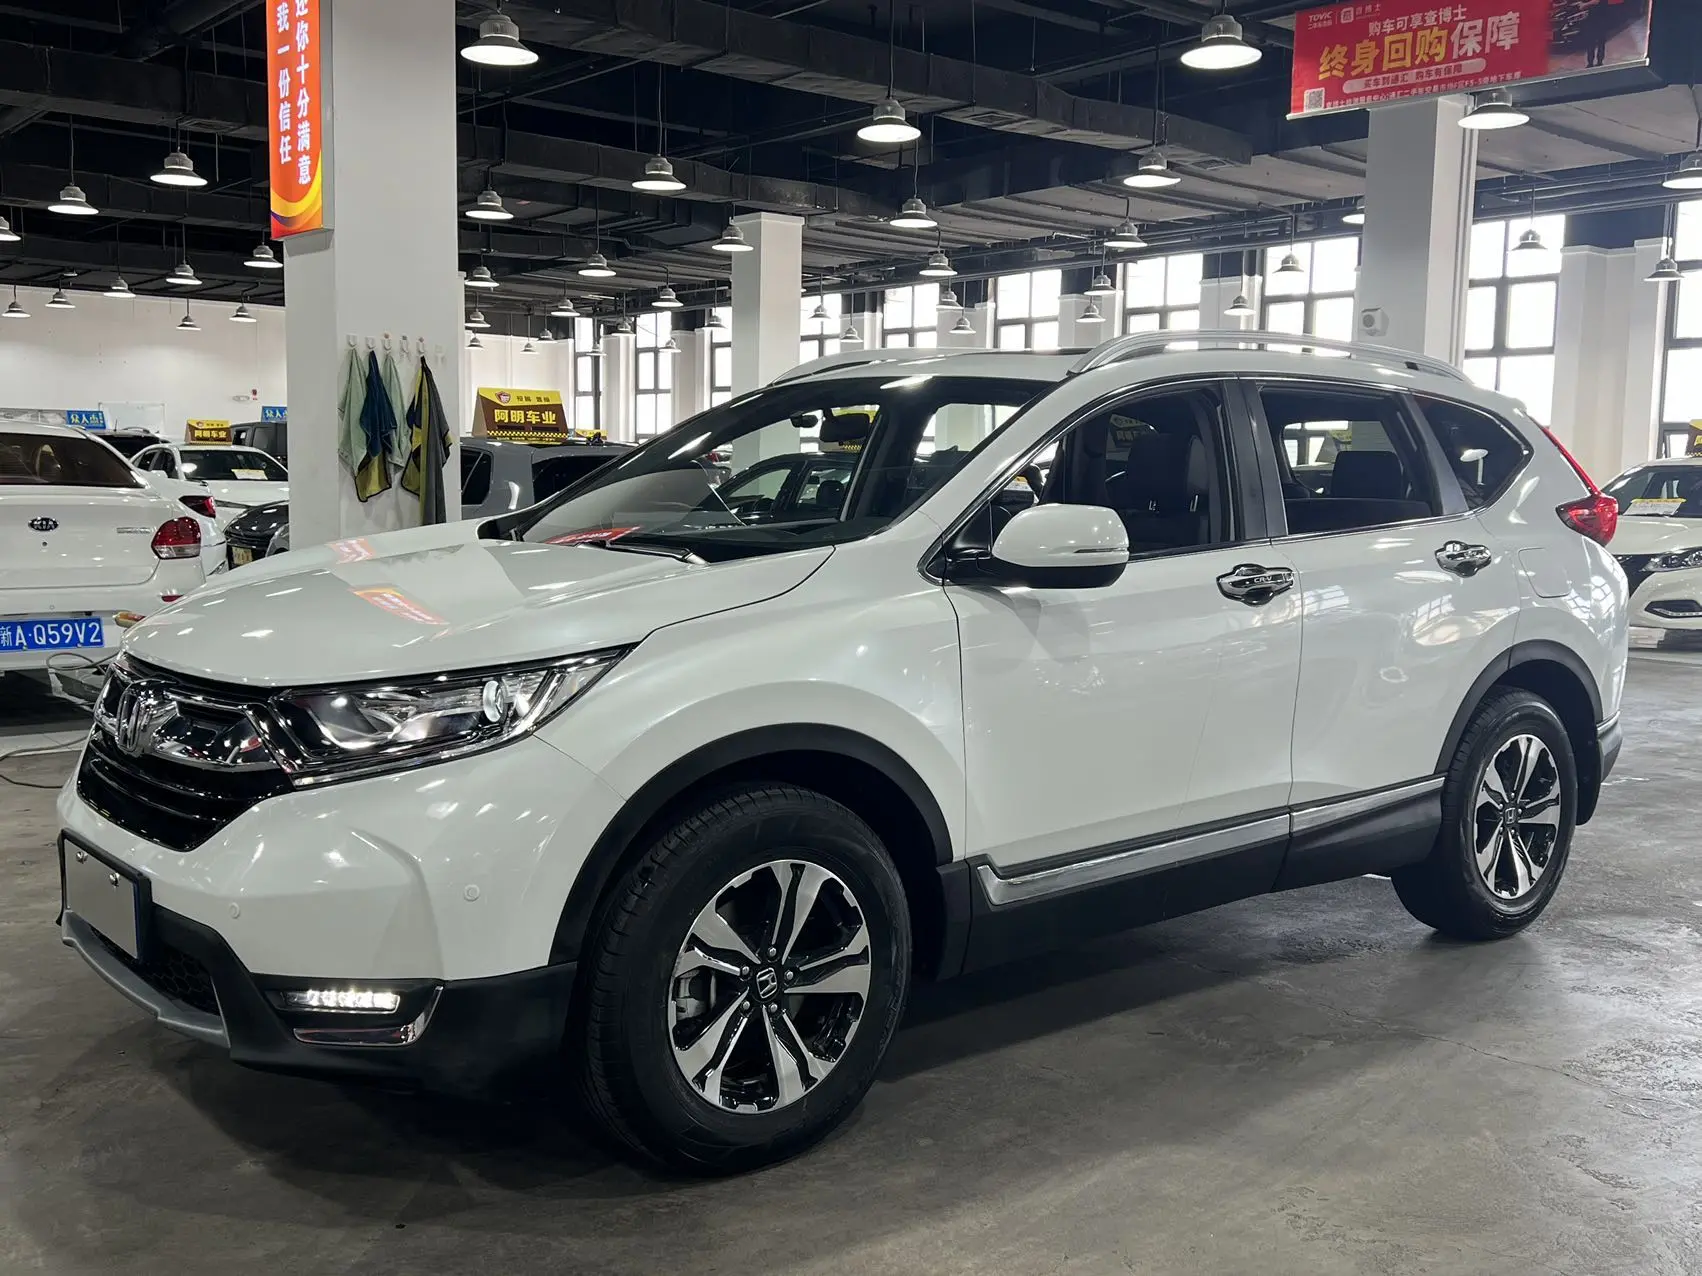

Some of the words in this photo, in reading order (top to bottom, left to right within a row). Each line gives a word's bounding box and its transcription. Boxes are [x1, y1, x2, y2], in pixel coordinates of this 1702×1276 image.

[1318, 11, 1520, 79] 终身回购保障
[1369, 4, 1467, 37] 购车可享查博士
[276, 2, 292, 165] 我一份信任
[494, 409, 557, 425] 阿明车业
